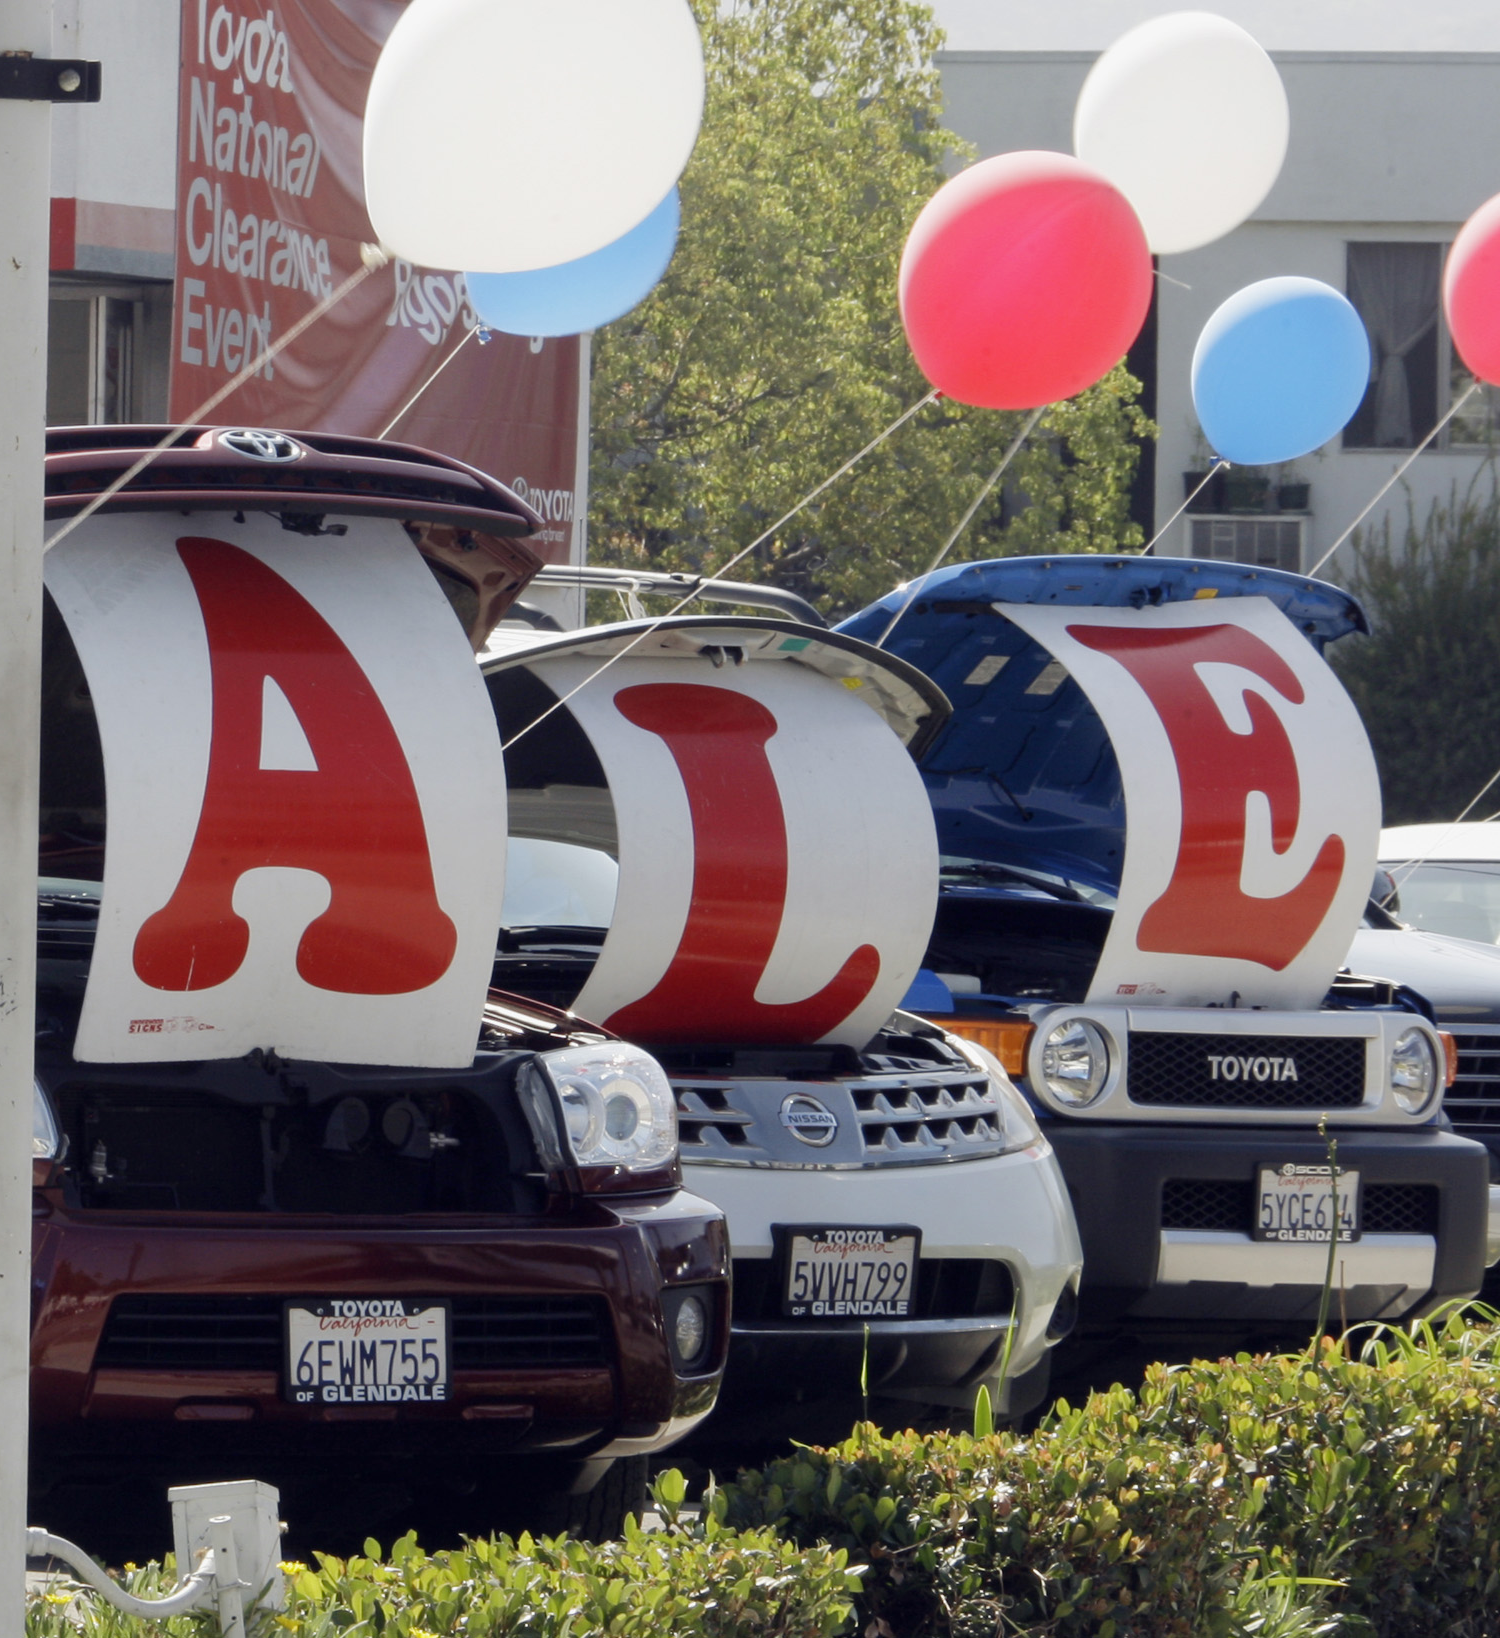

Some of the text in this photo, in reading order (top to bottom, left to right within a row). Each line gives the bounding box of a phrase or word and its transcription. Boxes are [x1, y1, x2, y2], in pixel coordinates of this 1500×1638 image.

[185, 176, 333, 300] Clearance
[181, 277, 274, 381] Event
[1208, 1056, 1298, 1081] TOYOTA
[788, 1114, 834, 1123] NISSAN
[826, 1231, 884, 1244] TOYOTA
[793, 1261, 908, 1301] 5VVH799
[331, 1300, 405, 1317] TOYOTA
[792, 1302, 908, 1315] OF GLENDALE
[296, 1338, 440, 1386] 6EWM755
[296, 1385, 445, 1402] OF GLENDALE
